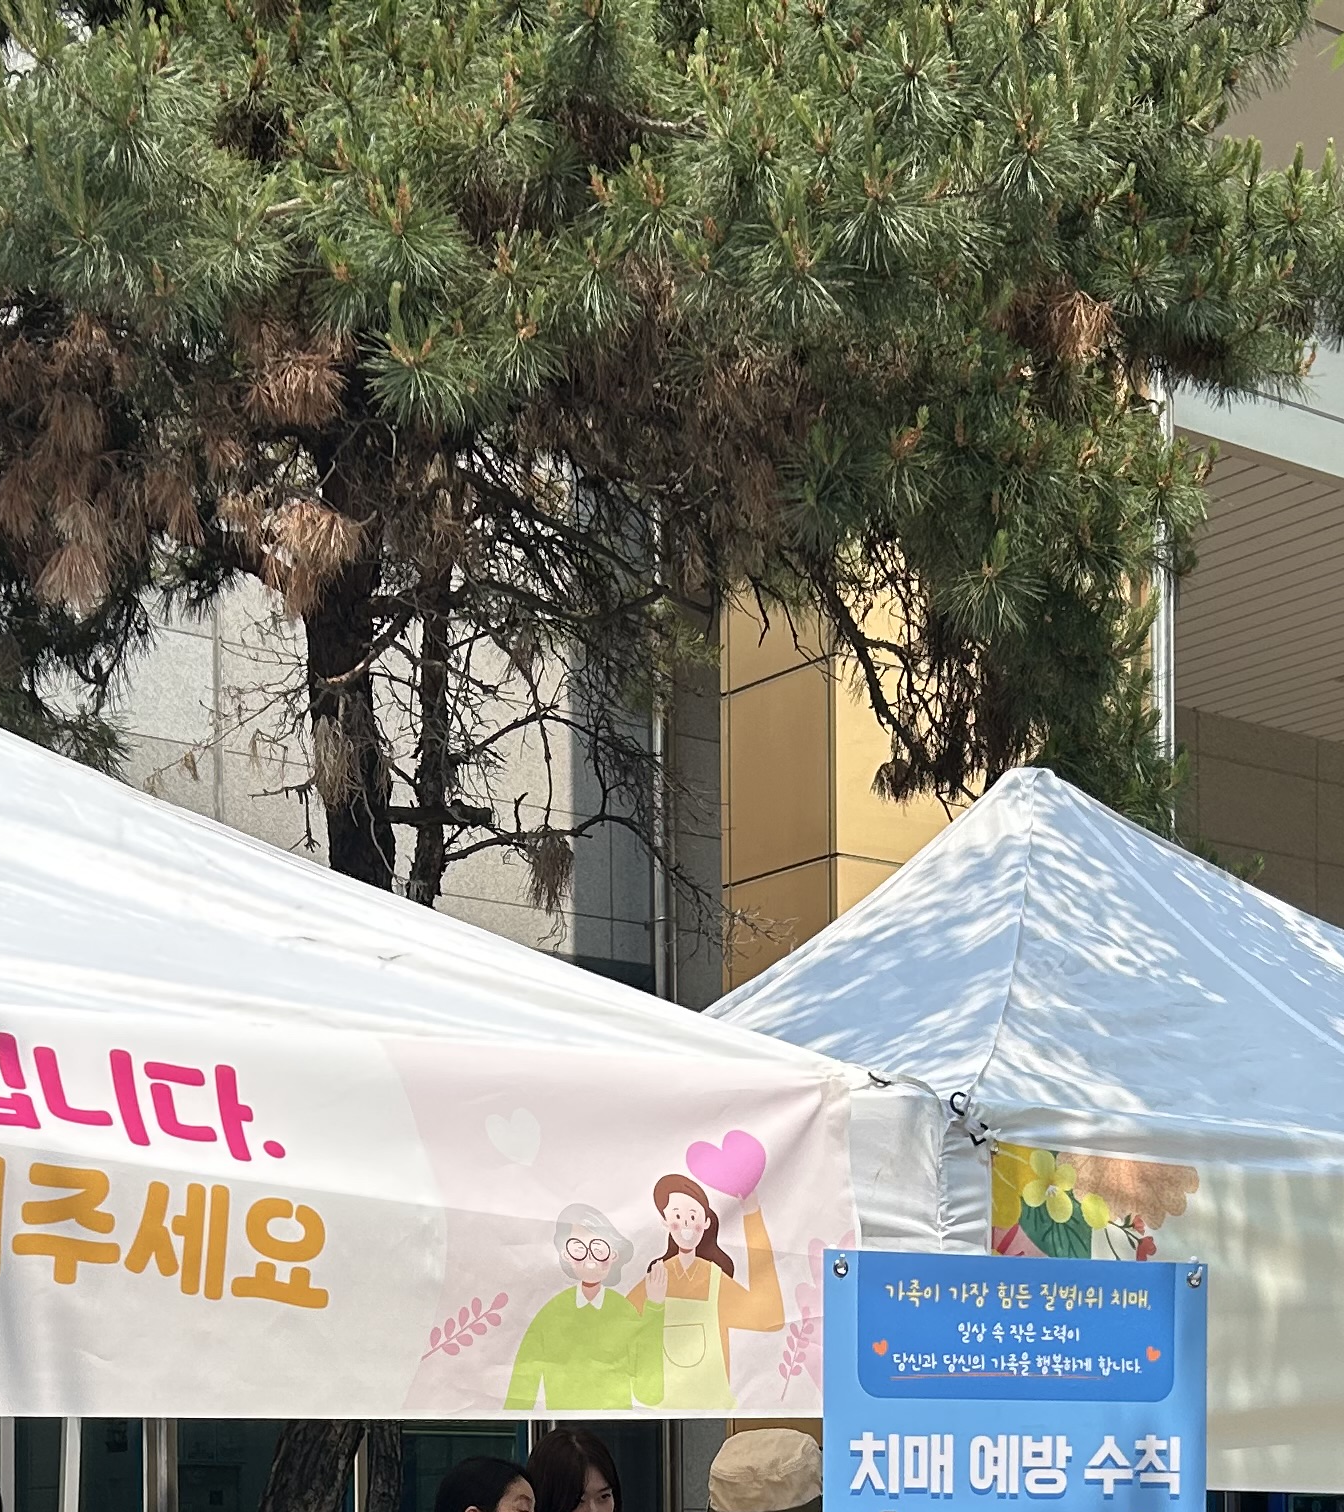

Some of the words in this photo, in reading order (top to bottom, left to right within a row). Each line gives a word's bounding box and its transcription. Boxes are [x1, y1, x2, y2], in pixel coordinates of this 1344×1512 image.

[885, 1279, 940, 1308] 가족이
[949, 1280, 989, 1309] 가장
[996, 1282, 1033, 1310] 힘든
[1110, 1286, 1151, 1311] 치매,
[958, 1322, 986, 1343] 일상
[992, 1323, 1005, 1343] 속
[1009, 1323, 1037, 1343] 작은
[1041, 1323, 1080, 1343] 노력이
[892, 1353, 937, 1373] 당신과
[943, 1354, 985, 1374] 당신의
[991, 1355, 1030, 1377] 가족을
[1036, 1355, 1092, 1377] 행복하게
[1097, 1355, 1142, 1377] 합니다.
[849, 1431, 953, 1496] 치매
[969, 1434, 1072, 1497] 예방
[1084, 1435, 1181, 1498] 수칙
